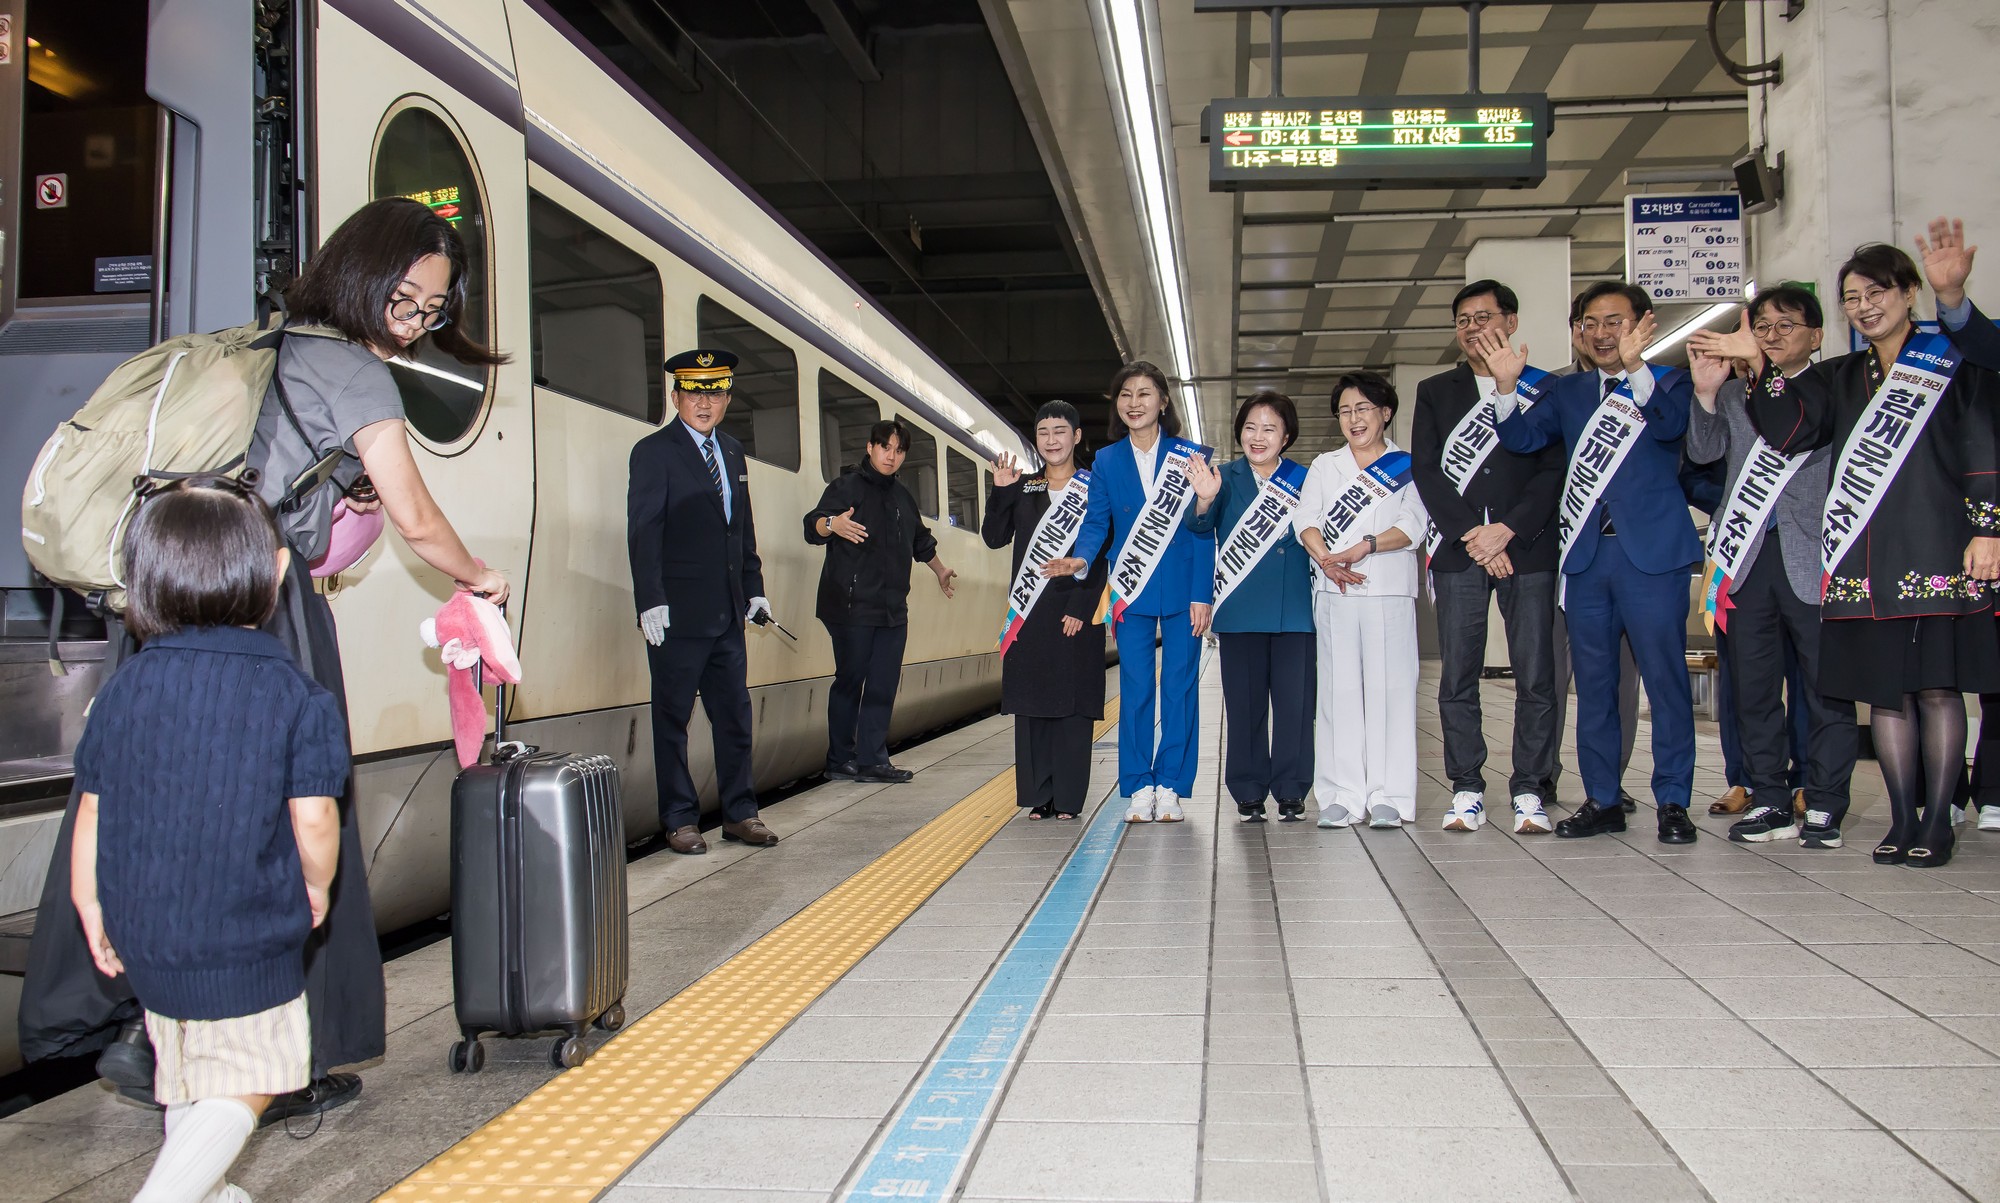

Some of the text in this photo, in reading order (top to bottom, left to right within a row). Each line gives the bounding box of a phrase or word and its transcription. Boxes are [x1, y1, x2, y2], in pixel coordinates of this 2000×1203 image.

[1224, 108, 1522, 127] 방향 출발시간 도착역 열차종류 열차번호
[1261, 129, 1310, 145] 09:44
[1320, 128, 1358, 145] 목포
[1393, 129, 1423, 144] KTX
[1484, 126, 1515, 142] 415
[1232, 149, 1337, 168] 나주-목포행
[1640, 202, 1684, 215] 호차번호
[1637, 226, 1659, 235] KTX
[1906, 350, 1954, 368] 조국혁신당
[1890, 370, 1943, 393] 행복할 권리
[1606, 398, 1631, 415] 행복할
[1357, 473, 1388, 498] 행복할 권리
[1371, 466, 1399, 487] 조국혁신당
[1266, 484, 1299, 508] 행복할 권리
[1719, 509, 1752, 569] 추석
[1821, 498, 1859, 564] 추석
[1117, 551, 1147, 597] 추석
[1013, 566, 1040, 612] 추석
